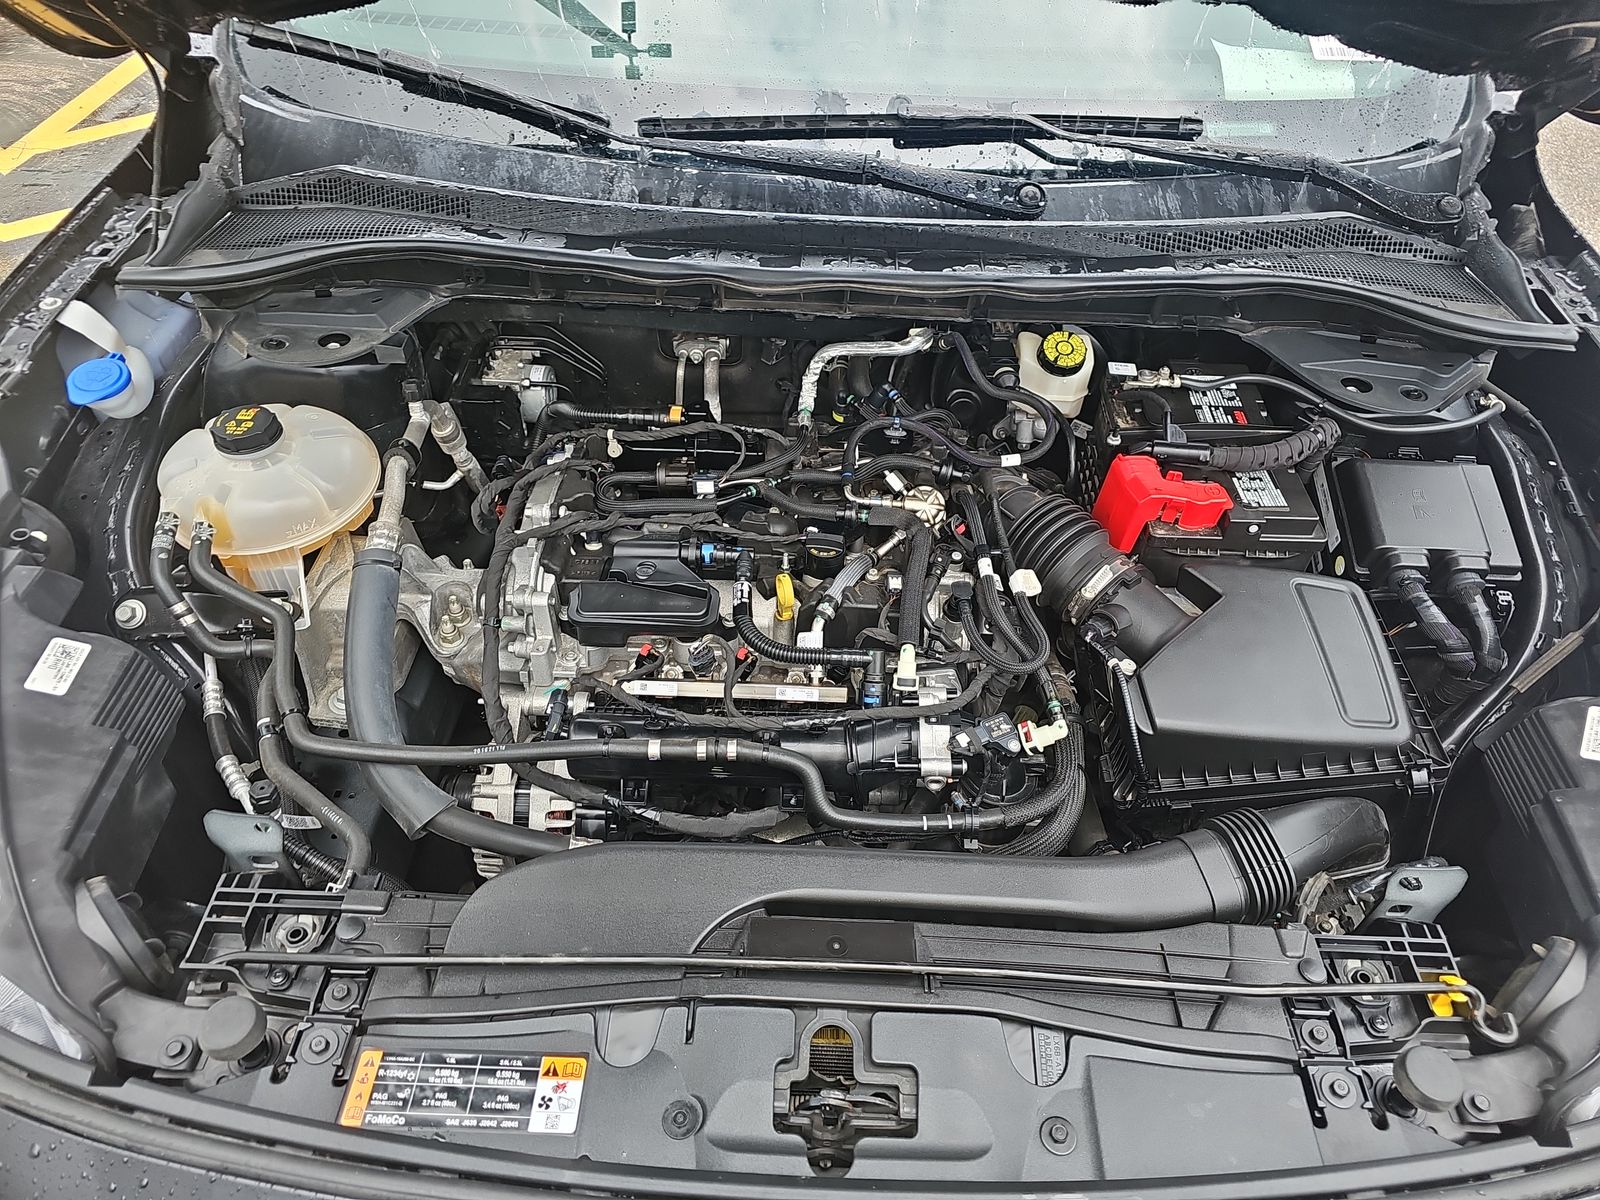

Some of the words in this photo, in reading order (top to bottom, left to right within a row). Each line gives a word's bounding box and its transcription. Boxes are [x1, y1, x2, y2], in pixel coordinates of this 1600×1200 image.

[378, 1068, 408, 1078] R-1234yf
[451, 1069, 459, 1079] kg
[512, 1070, 520, 1080] kg
[372, 1092, 388, 1100] PAG
[365, 1114, 405, 1125] FoMoCo
